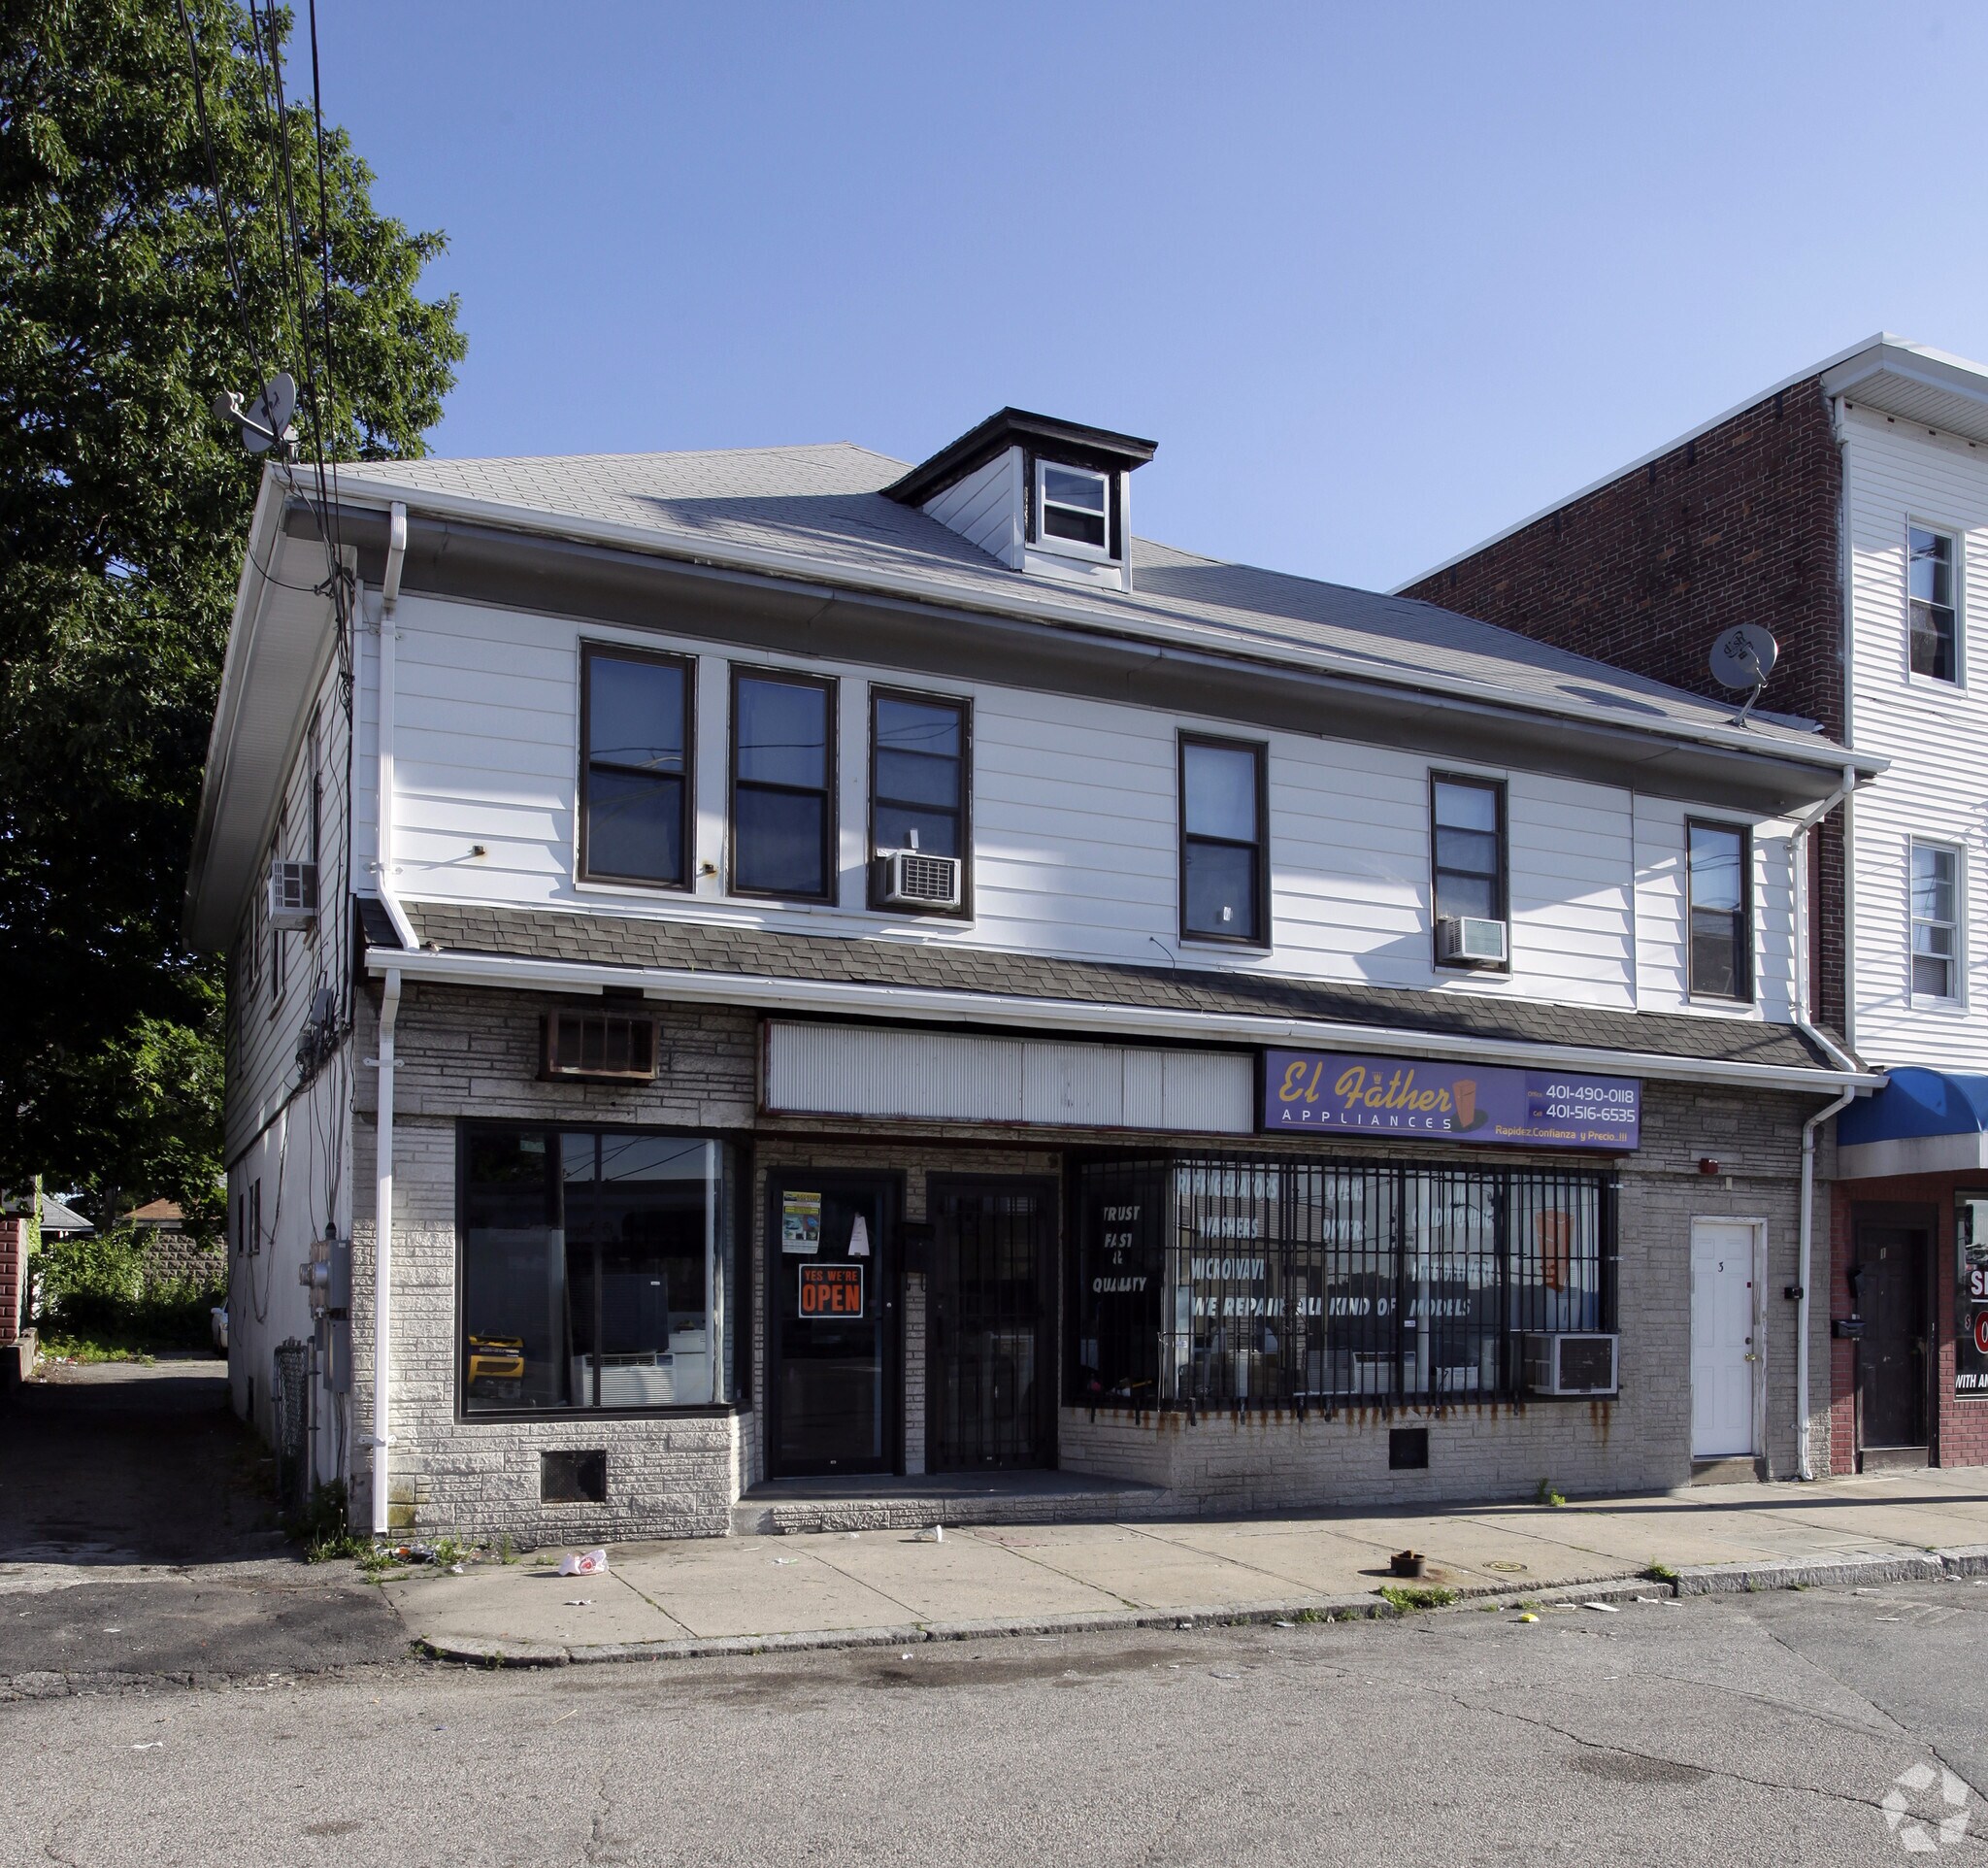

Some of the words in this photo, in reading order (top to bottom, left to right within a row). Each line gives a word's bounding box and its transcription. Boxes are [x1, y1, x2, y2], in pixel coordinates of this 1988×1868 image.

[1278, 1061, 1323, 1103] El
[1334, 1066, 1452, 1113] Father
[1545, 1084, 1635, 1104] 401-490-0118
[1281, 1109, 1452, 1129] APPLIANCES
[1545, 1104, 1636, 1122] 401-516-6535
[1580, 1132, 1586, 1142] y
[1104, 1206, 1141, 1221] TRUST
[1200, 1217, 1259, 1239] WASHERS
[1105, 1233, 1132, 1248] FAST
[1717, 1261, 1724, 1273] 3
[805, 1271, 823, 1282] YES
[827, 1271, 857, 1282] WE'RE
[1093, 1277, 1146, 1293] QUALITY
[802, 1284, 860, 1312] OPEN
[1192, 1297, 1217, 1317] WE
[1295, 1297, 1322, 1316] ALL
[1329, 1297, 1371, 1316] KIND
[1376, 1297, 1397, 1317] OF
[1409, 1299, 1471, 1317] MODELS
[1955, 1374, 1977, 1388] WITH
